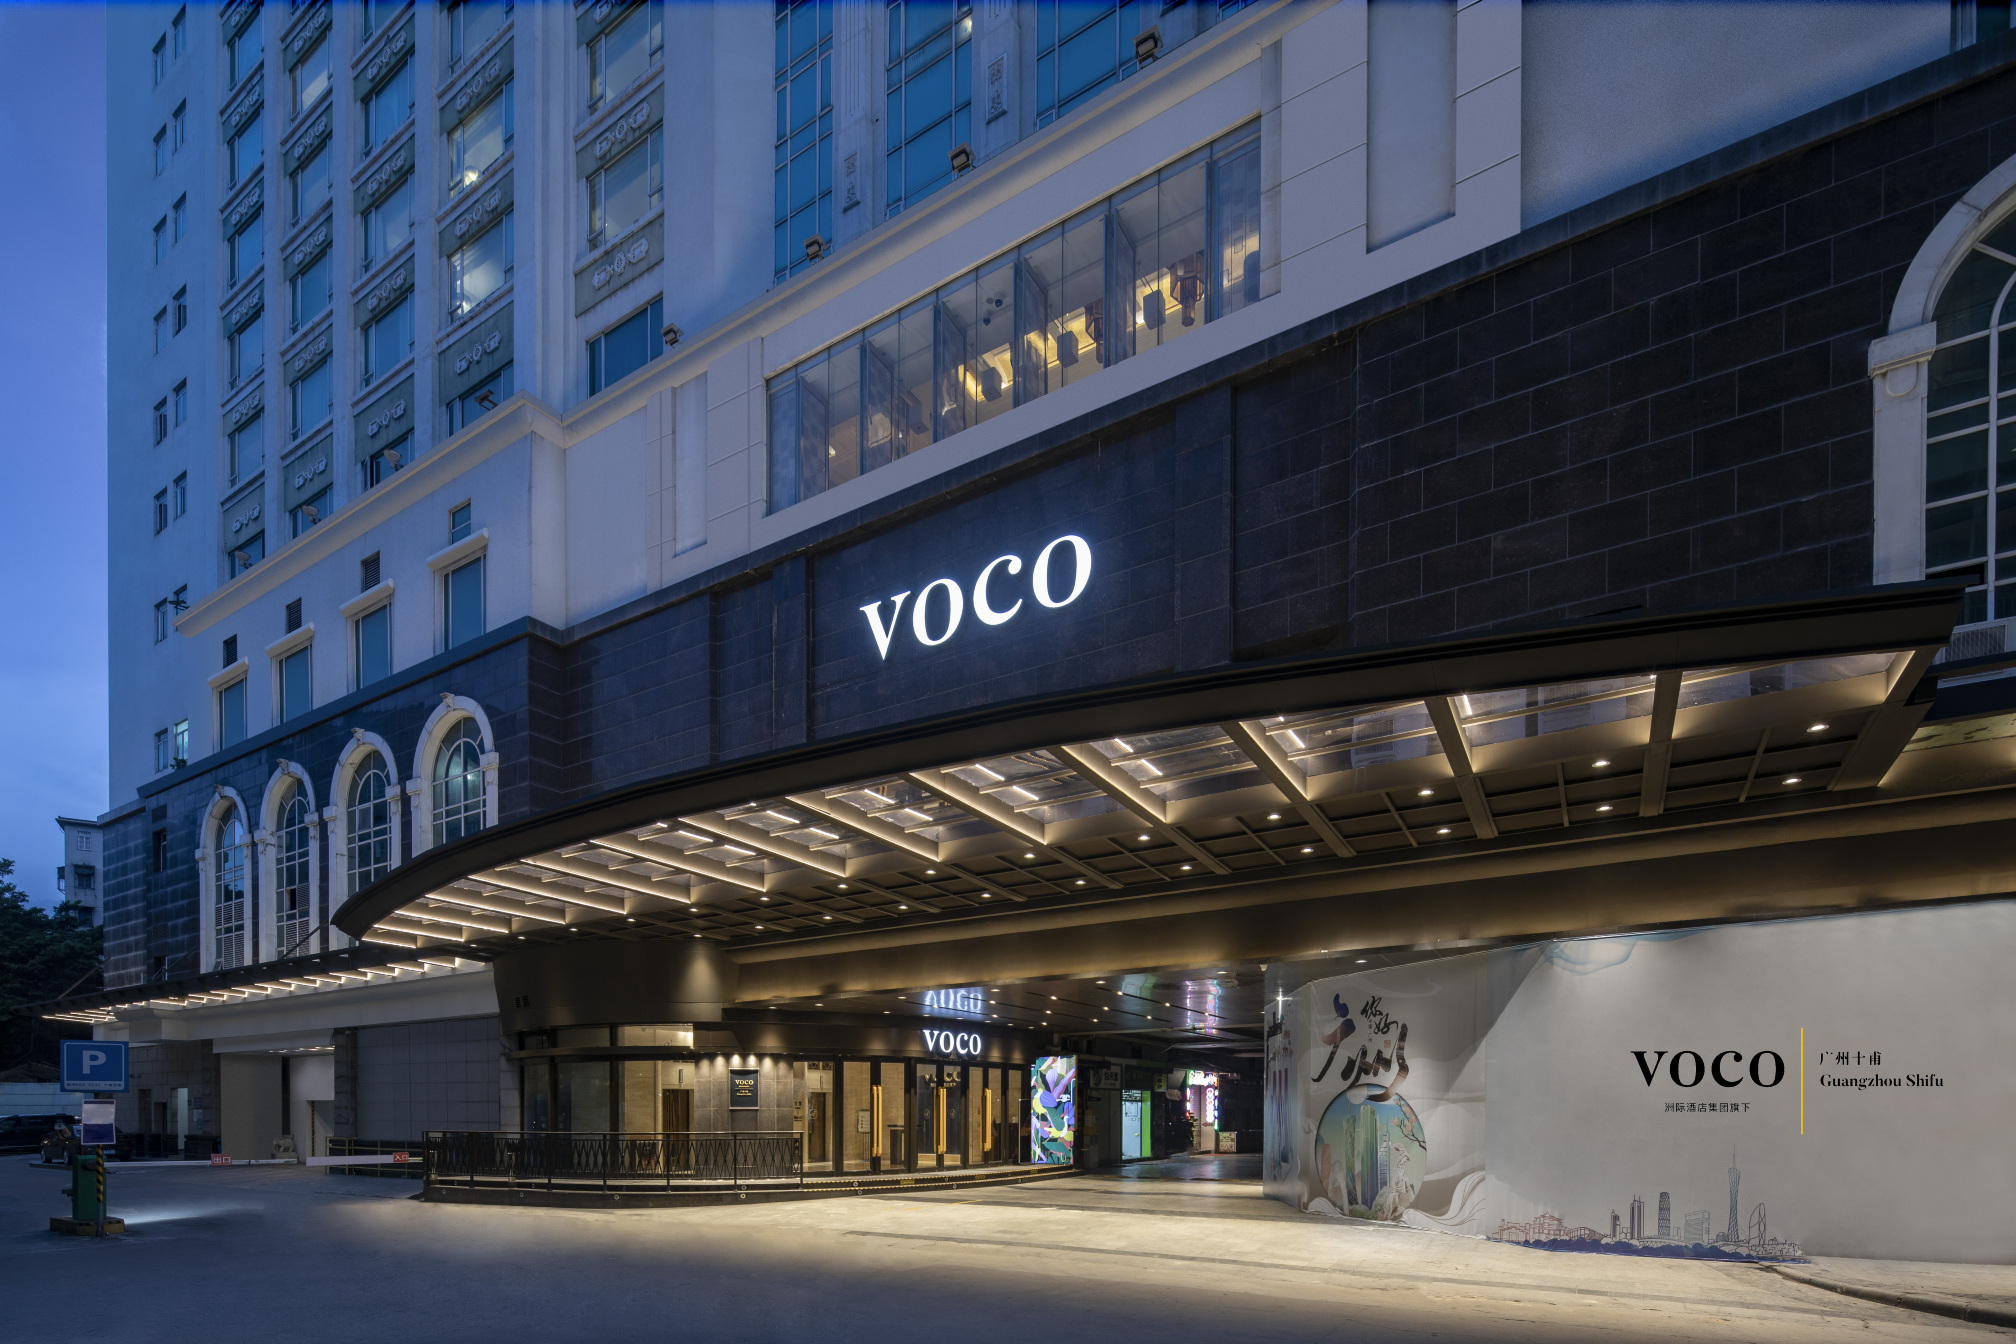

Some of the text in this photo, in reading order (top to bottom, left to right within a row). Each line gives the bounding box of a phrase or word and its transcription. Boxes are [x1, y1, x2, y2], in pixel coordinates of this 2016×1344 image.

[82, 1050, 107, 1075] P
[1819, 1050, 1882, 1066] 广州十甫
[1819, 1073, 1944, 1091] Guangzhou Shifu
[1664, 1102, 1751, 1113] 洲际酒店集团旗下
[213, 1156, 231, 1164] 出口
[394, 1154, 409, 1162] 入口
